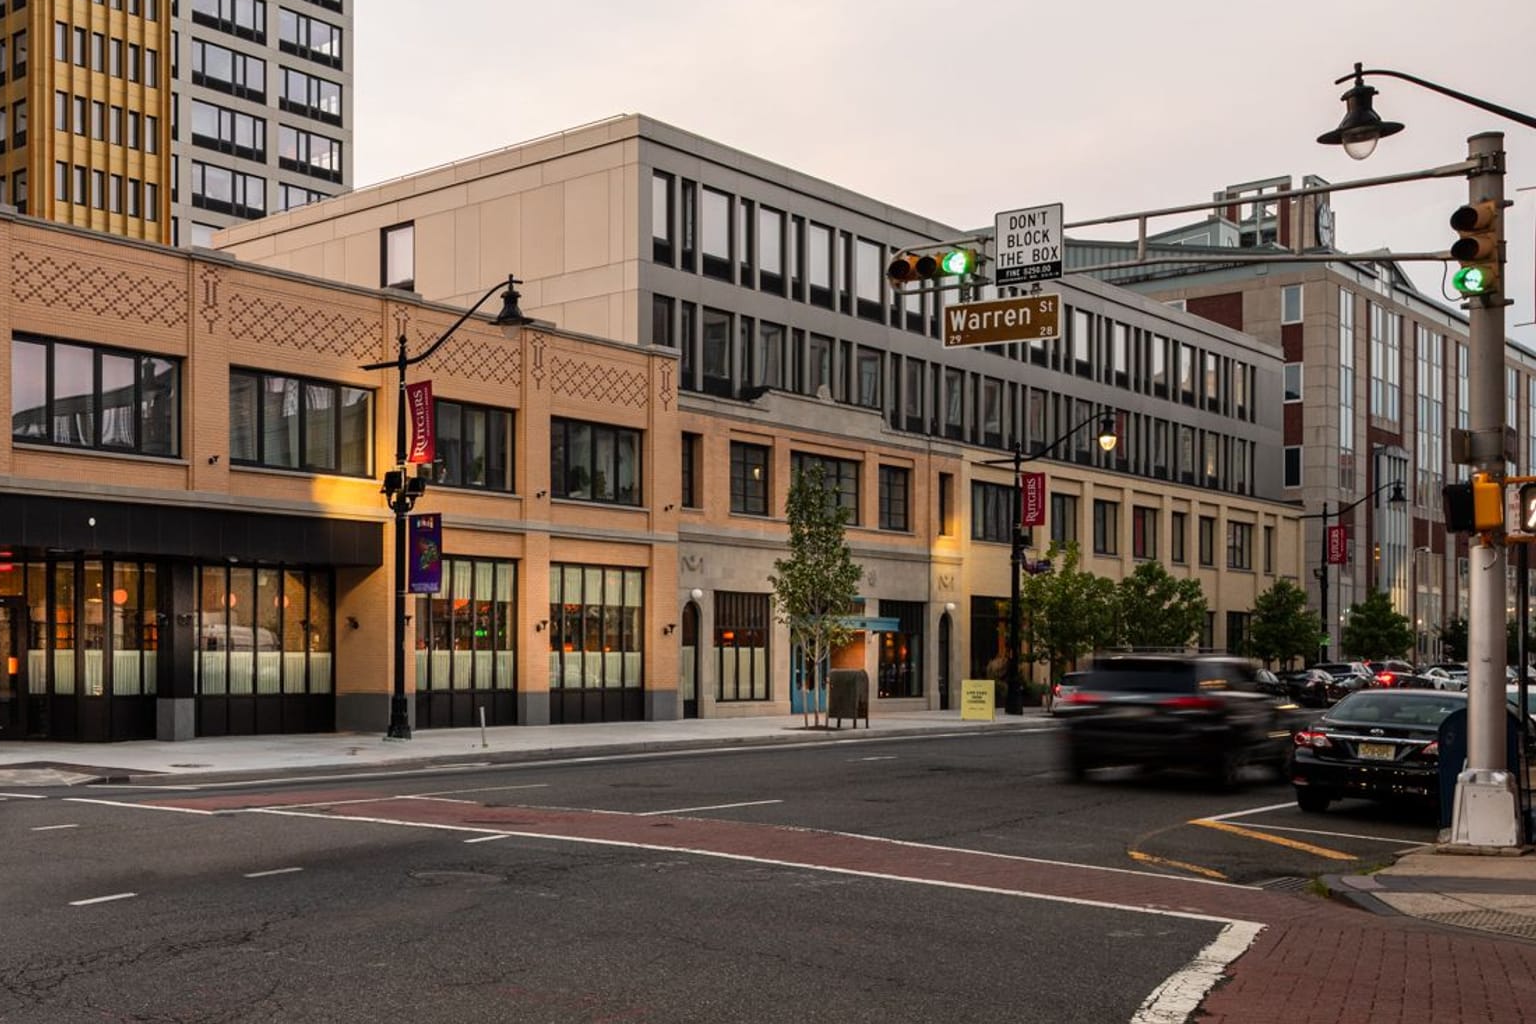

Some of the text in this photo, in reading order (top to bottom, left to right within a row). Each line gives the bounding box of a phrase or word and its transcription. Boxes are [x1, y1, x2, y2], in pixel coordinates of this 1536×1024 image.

[1009, 211, 1047, 230] DON'T
[1007, 229, 1050, 248] BLOCK
[1000, 245, 1058, 267] THE BOX
[950, 300, 1053, 332] Warren St
[949, 335, 962, 345] 29
[1040, 326, 1053, 336] 28
[413, 389, 429, 456] RUTGERS
[1025, 478, 1040, 522] RUTGERS
